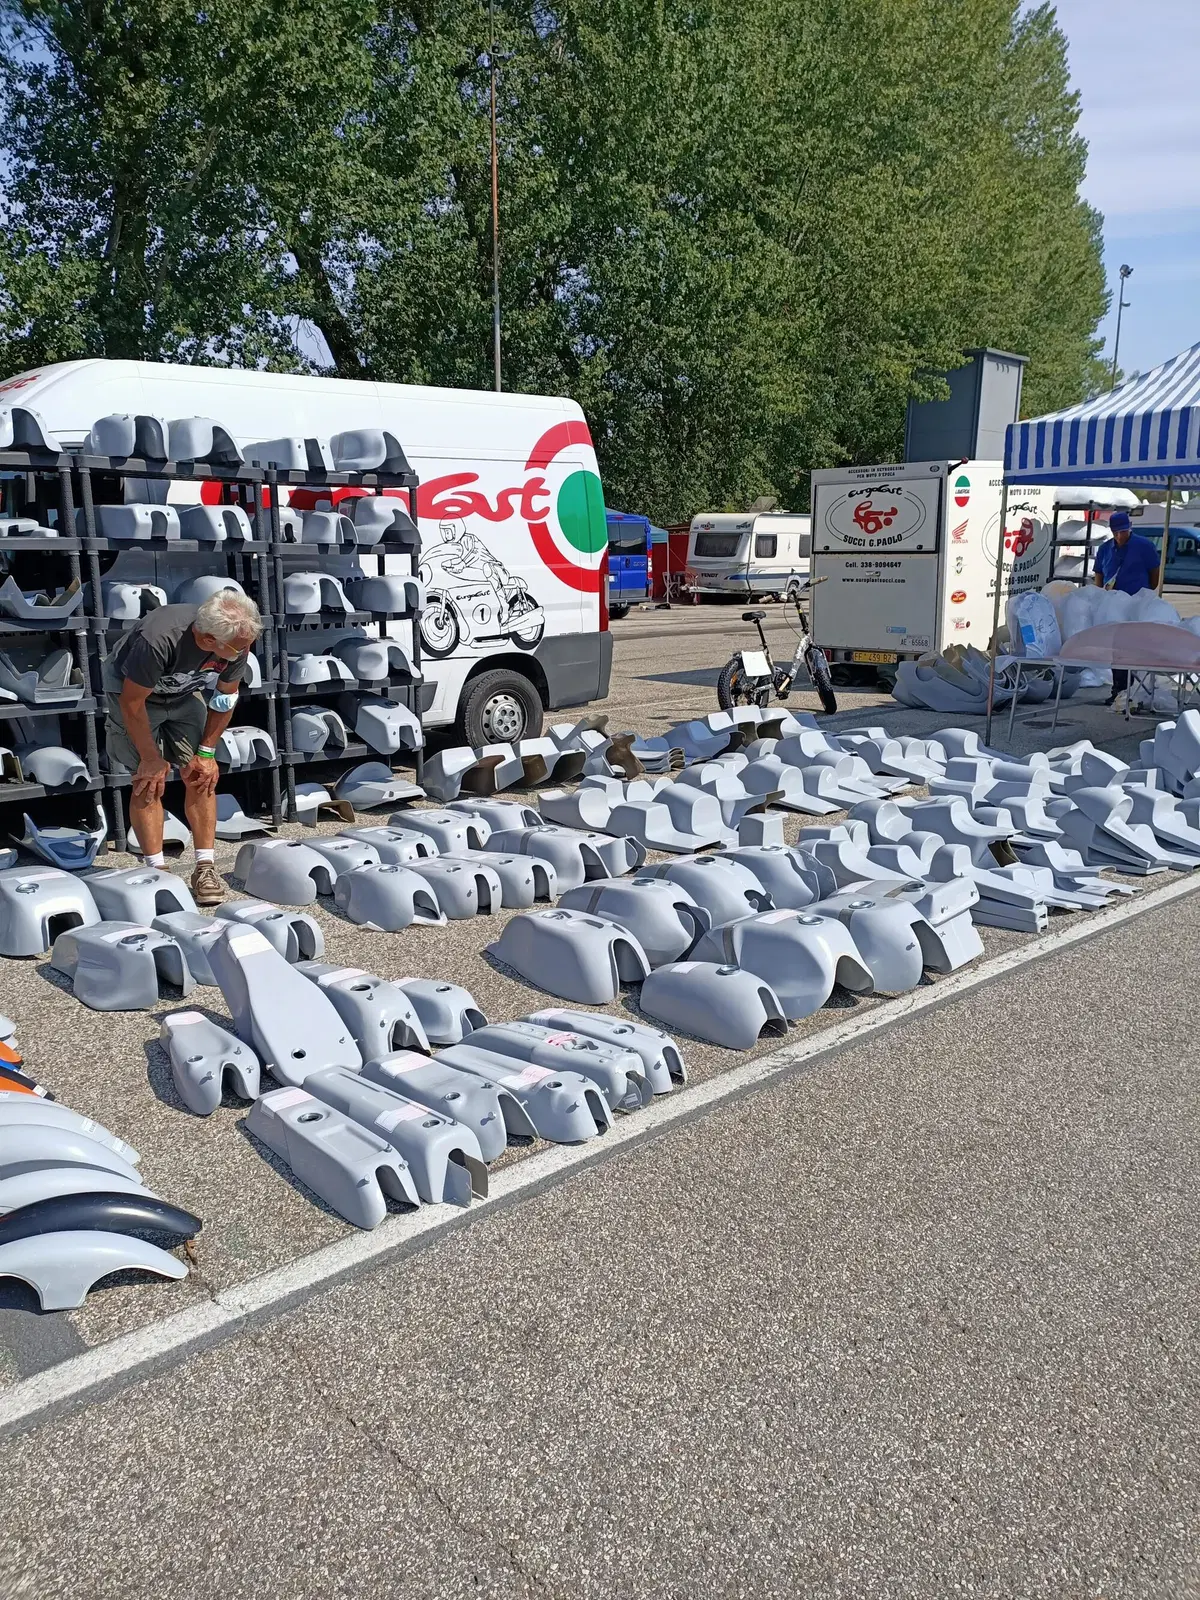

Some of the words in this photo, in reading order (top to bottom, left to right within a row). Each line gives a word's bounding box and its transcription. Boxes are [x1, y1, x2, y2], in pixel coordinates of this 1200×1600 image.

[843, 535, 866, 547] SUCCI
[868, 533, 903, 547] G.PAOLO
[479, 608, 485, 621] 1
